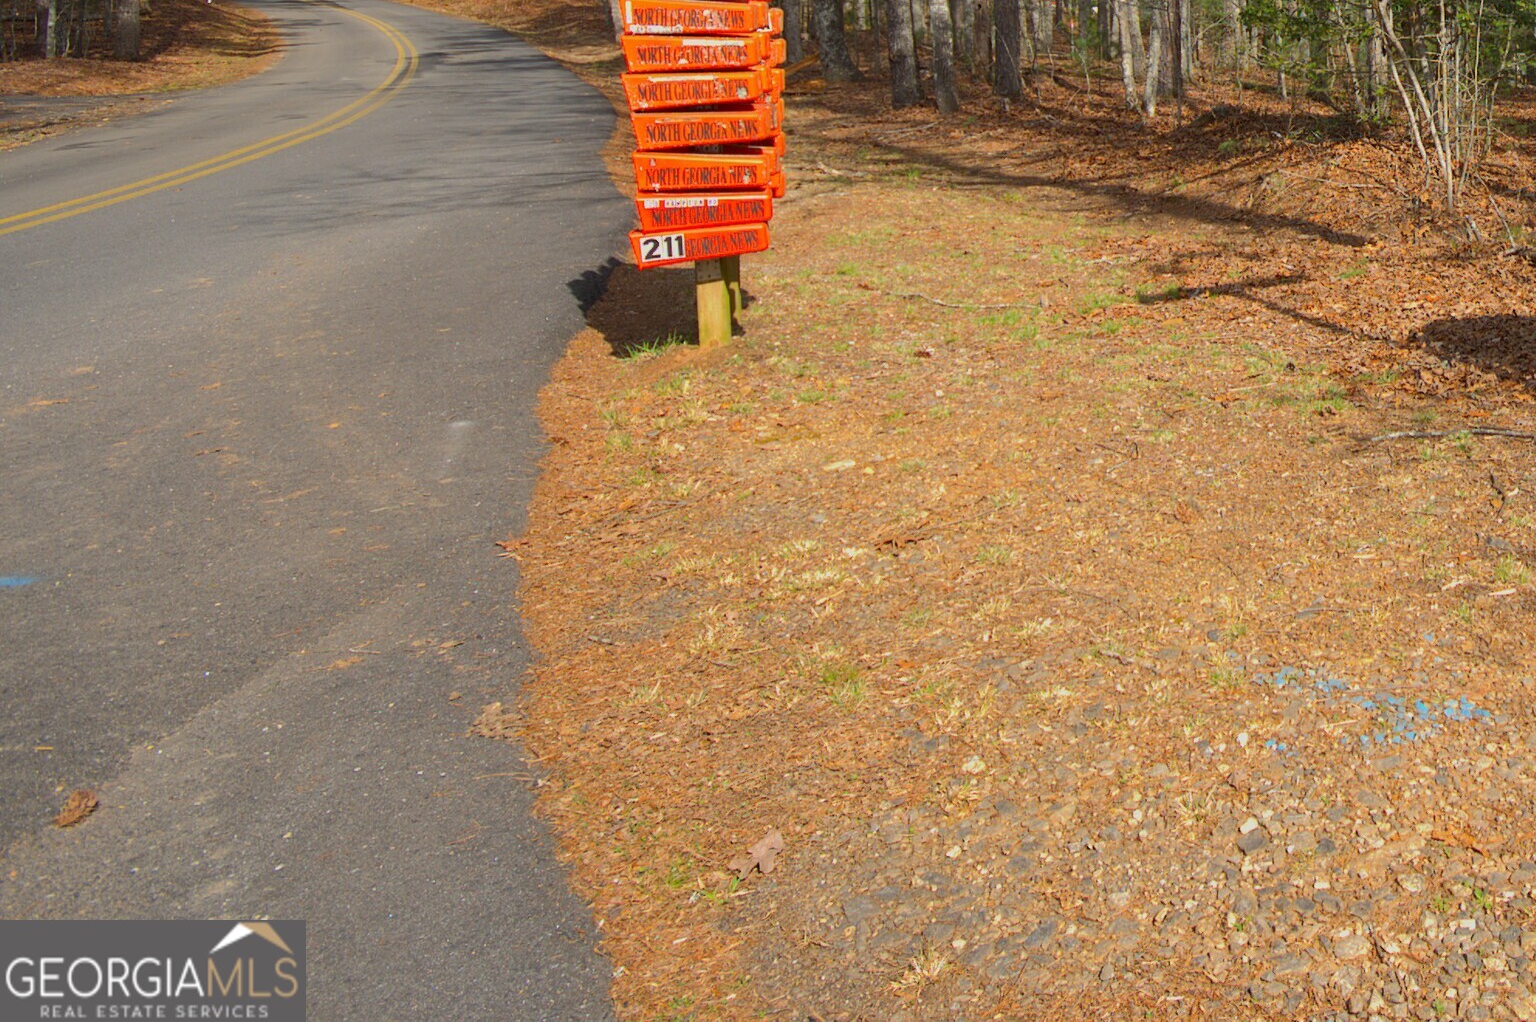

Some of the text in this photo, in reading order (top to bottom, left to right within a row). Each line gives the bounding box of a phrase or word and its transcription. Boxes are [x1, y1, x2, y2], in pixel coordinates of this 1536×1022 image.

[633, 8, 745, 28] NORTH GEORGIA NEWS
[637, 44, 748, 65] NORTH GEORGIA NEWS
[637, 79, 749, 101] NORTH GEORGIA NEWS
[646, 120, 758, 143] NORTH GEORGIA NEWS
[645, 165, 757, 186] NORTH GEORGIA NEWS
[651, 202, 764, 227] NORTH GEORGIA NEWS
[643, 235, 685, 260] 211
[685, 230, 758, 257] GEORGIA NEWS
